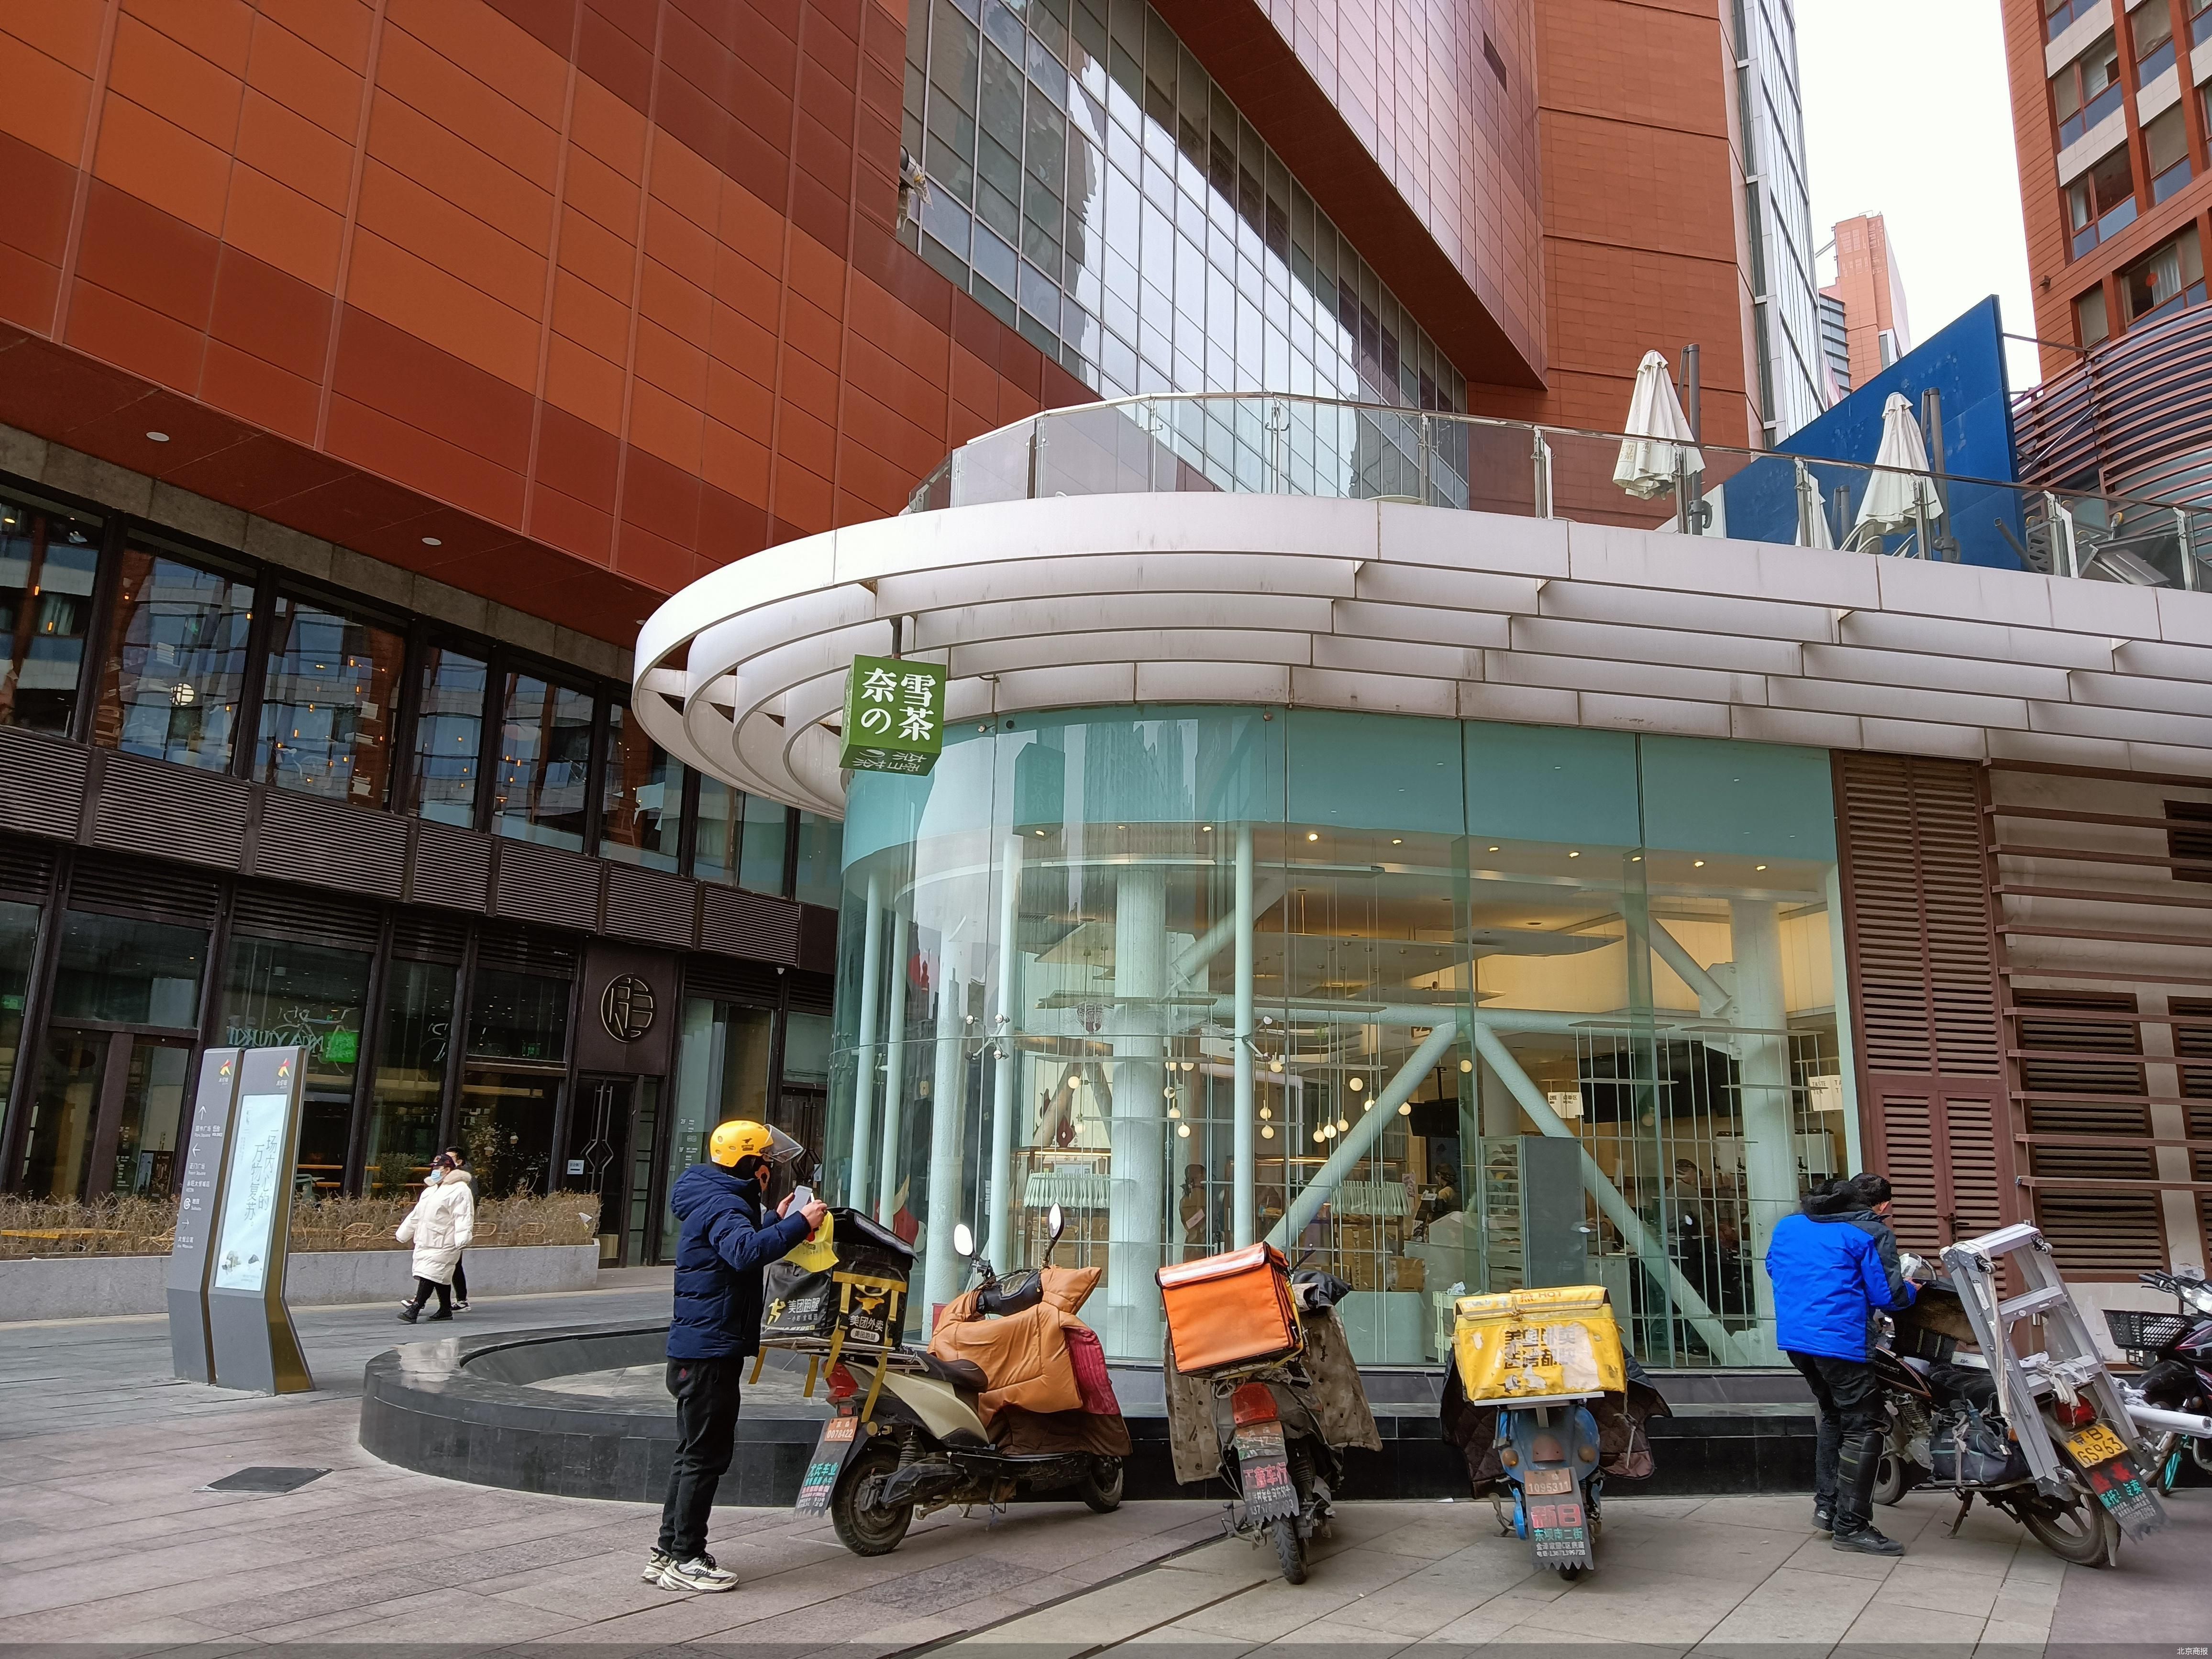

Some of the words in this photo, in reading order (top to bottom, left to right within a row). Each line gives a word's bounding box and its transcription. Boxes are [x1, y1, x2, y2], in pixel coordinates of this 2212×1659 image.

[861, 667, 936, 707] 奈雪
[861, 706, 934, 741] の茶
[787, 1297, 820, 1314] 美团跑腿
[850, 1315, 884, 1332] 美团外卖
[827, 1429, 853, 1439] 0078422
[1529, 1481, 1570, 1493] 1095311
[1531, 1503, 1582, 1528] 新日
